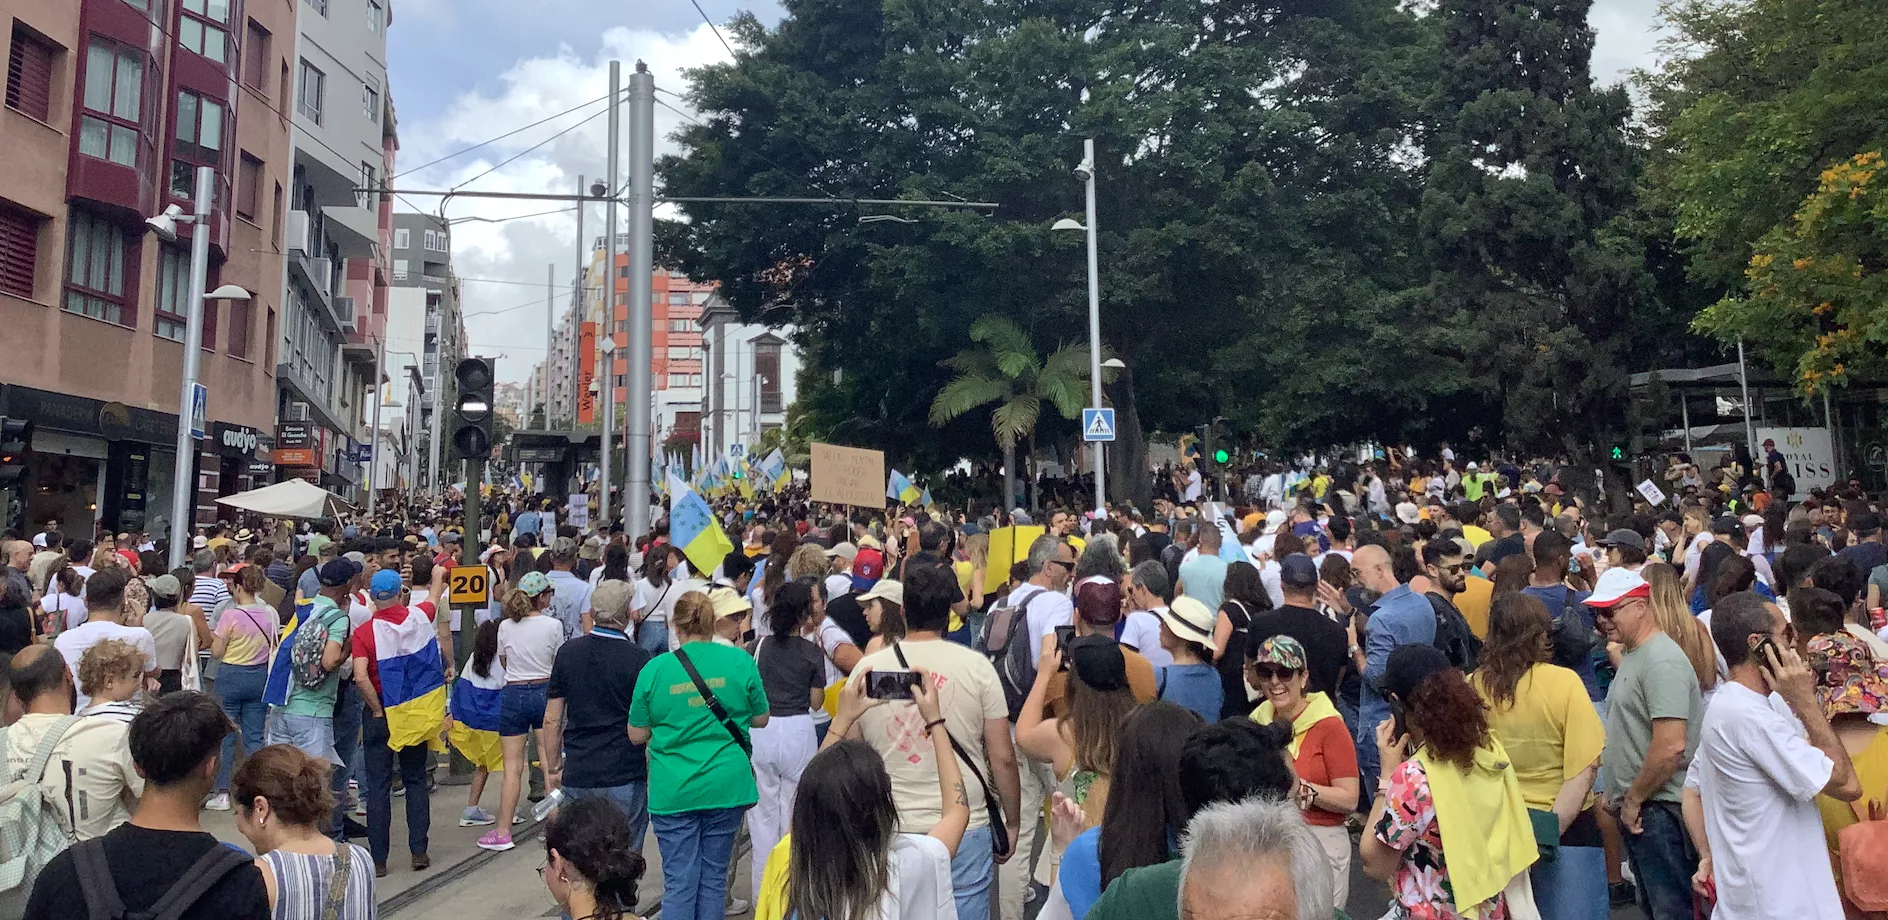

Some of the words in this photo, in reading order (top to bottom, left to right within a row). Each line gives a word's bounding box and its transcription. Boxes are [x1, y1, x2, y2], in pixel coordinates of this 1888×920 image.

[1786, 453, 1814, 461] OYAL
[1795, 463, 1830, 478] ISS
[453, 575, 484, 594] 20
